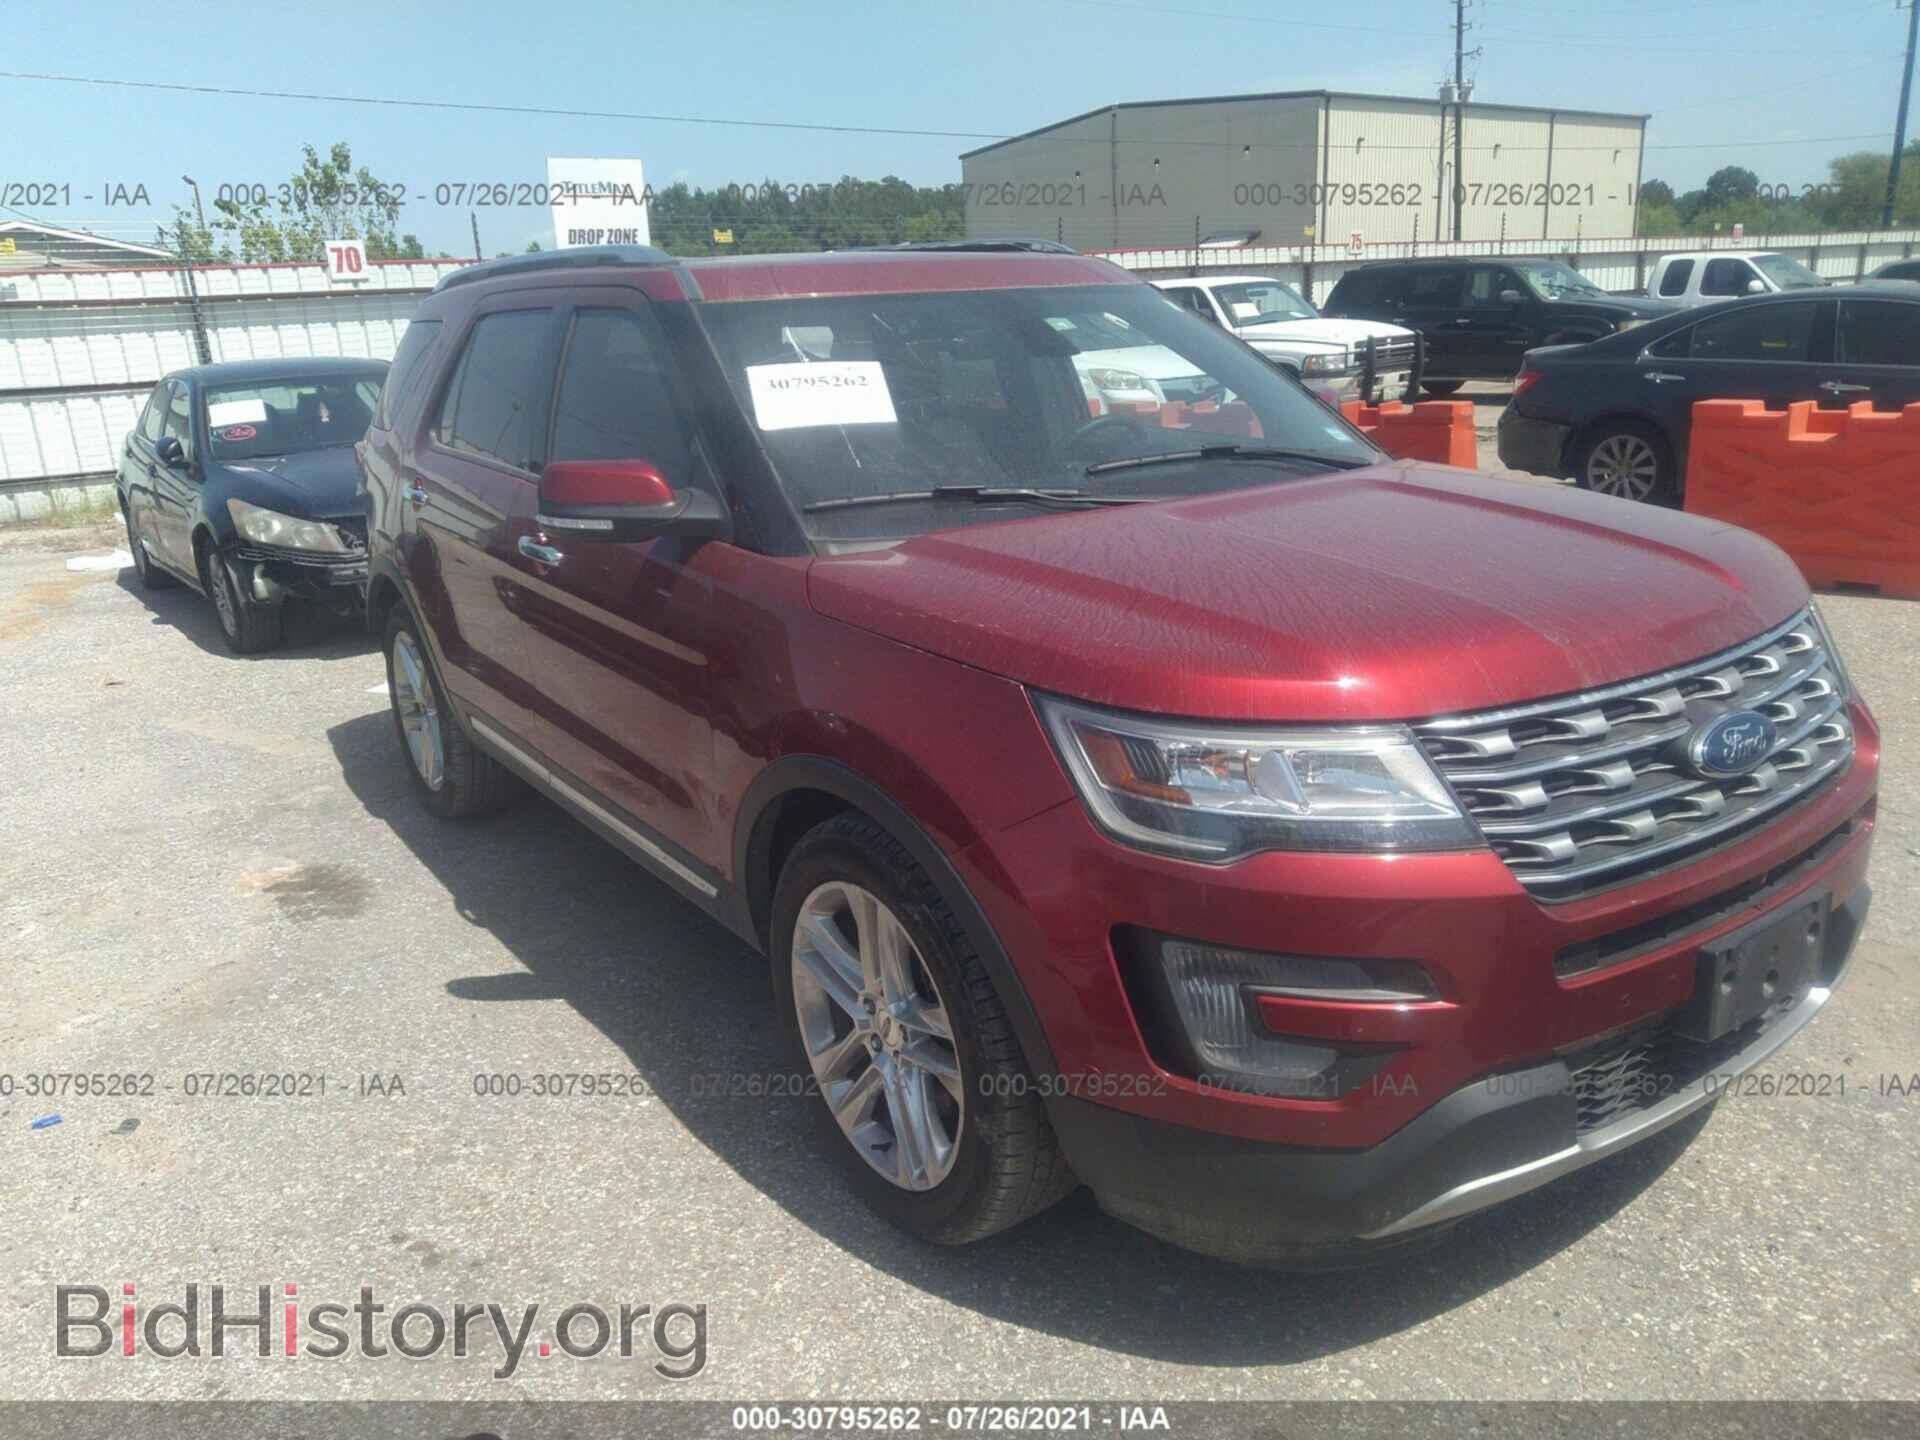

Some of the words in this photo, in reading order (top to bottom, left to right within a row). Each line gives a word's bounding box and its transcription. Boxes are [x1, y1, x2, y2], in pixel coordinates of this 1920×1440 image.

[568, 229, 603, 245] DROP
[607, 229, 638, 245] ZONE
[330, 246, 362, 273] 70
[768, 375, 869, 390] 30795262
[1722, 722, 1767, 763] Ford
